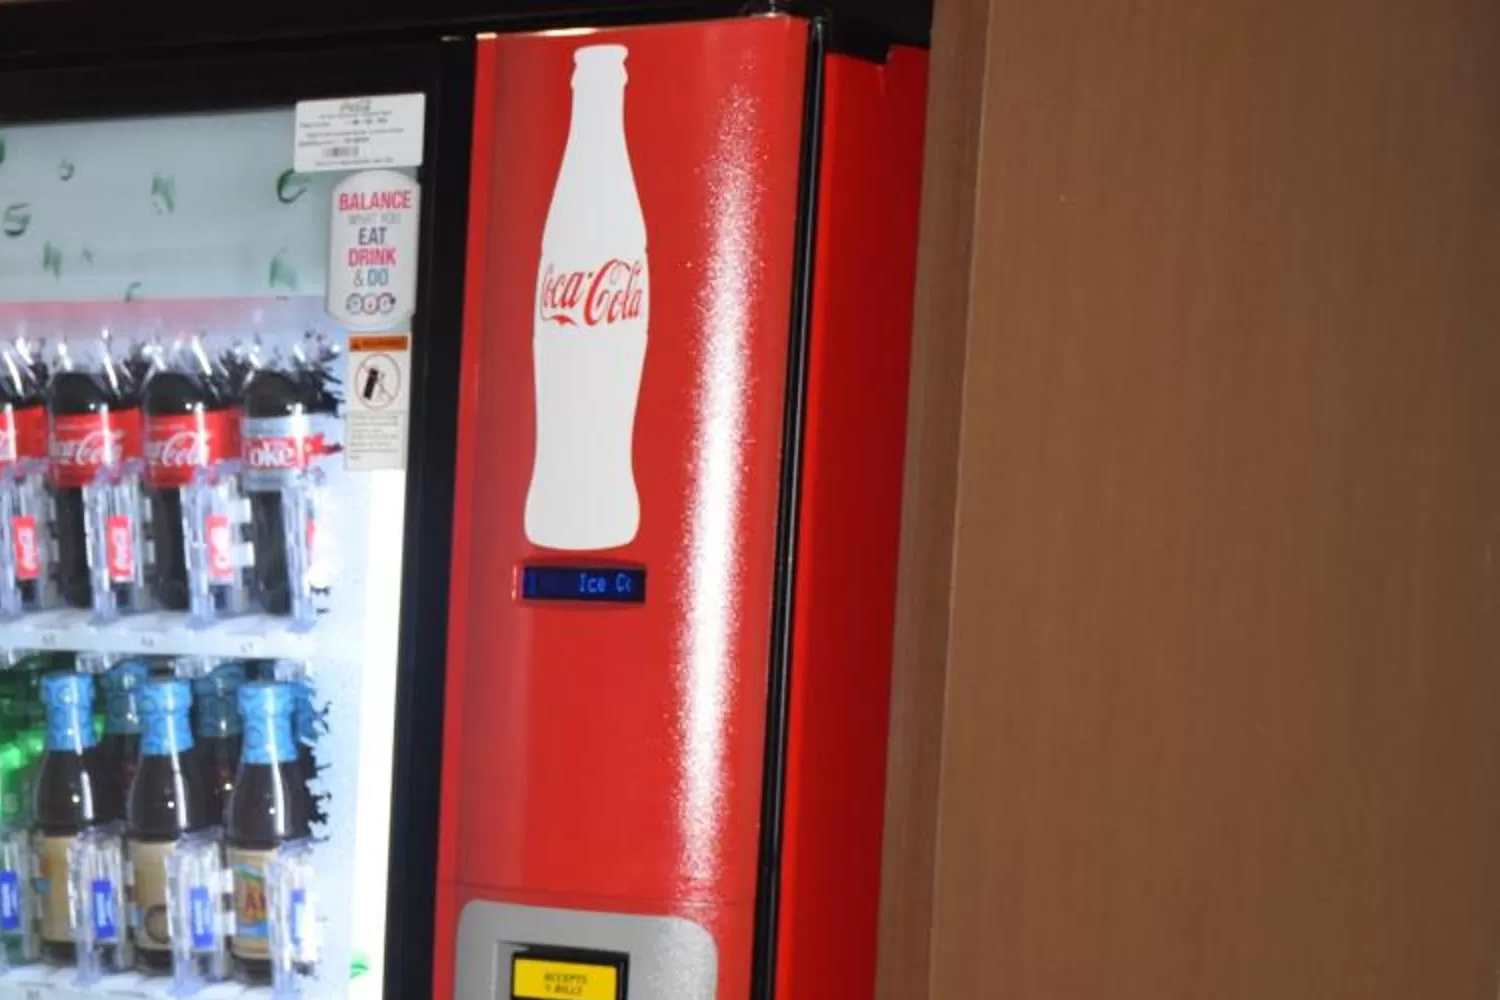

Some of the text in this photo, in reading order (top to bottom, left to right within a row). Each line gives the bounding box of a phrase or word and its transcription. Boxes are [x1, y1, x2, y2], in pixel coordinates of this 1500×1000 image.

[339, 191, 411, 210] BALANCE
[358, 226, 387, 245] EAT
[348, 247, 397, 267] DRINK
[367, 267, 389, 286] DO
